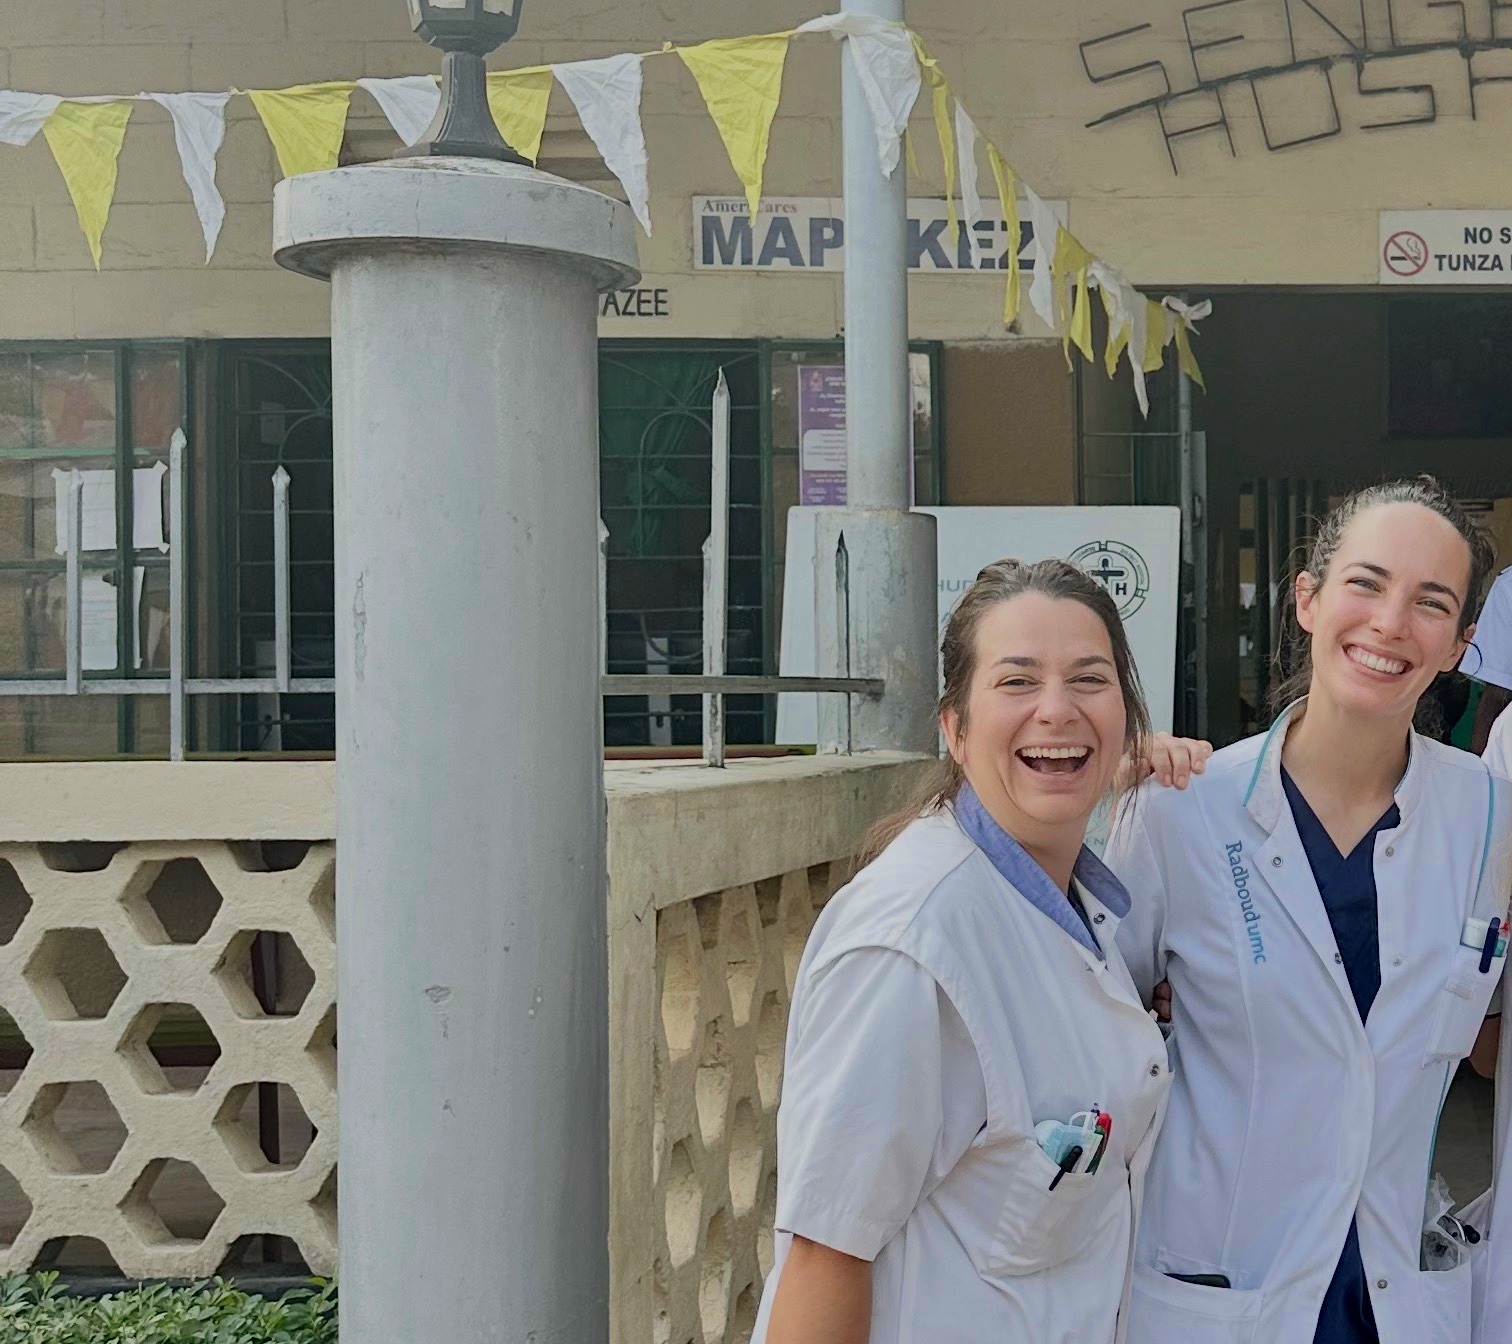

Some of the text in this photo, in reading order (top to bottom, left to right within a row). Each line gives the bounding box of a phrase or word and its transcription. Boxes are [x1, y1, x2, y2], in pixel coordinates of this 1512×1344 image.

[702, 216, 1052, 269] MAPKEZ
[1464, 227, 1493, 244] NO
[1434, 254, 1503, 272] TUNZA
[602, 288, 668, 316] AZEE
[1225, 840, 1267, 964] Radboudumc
